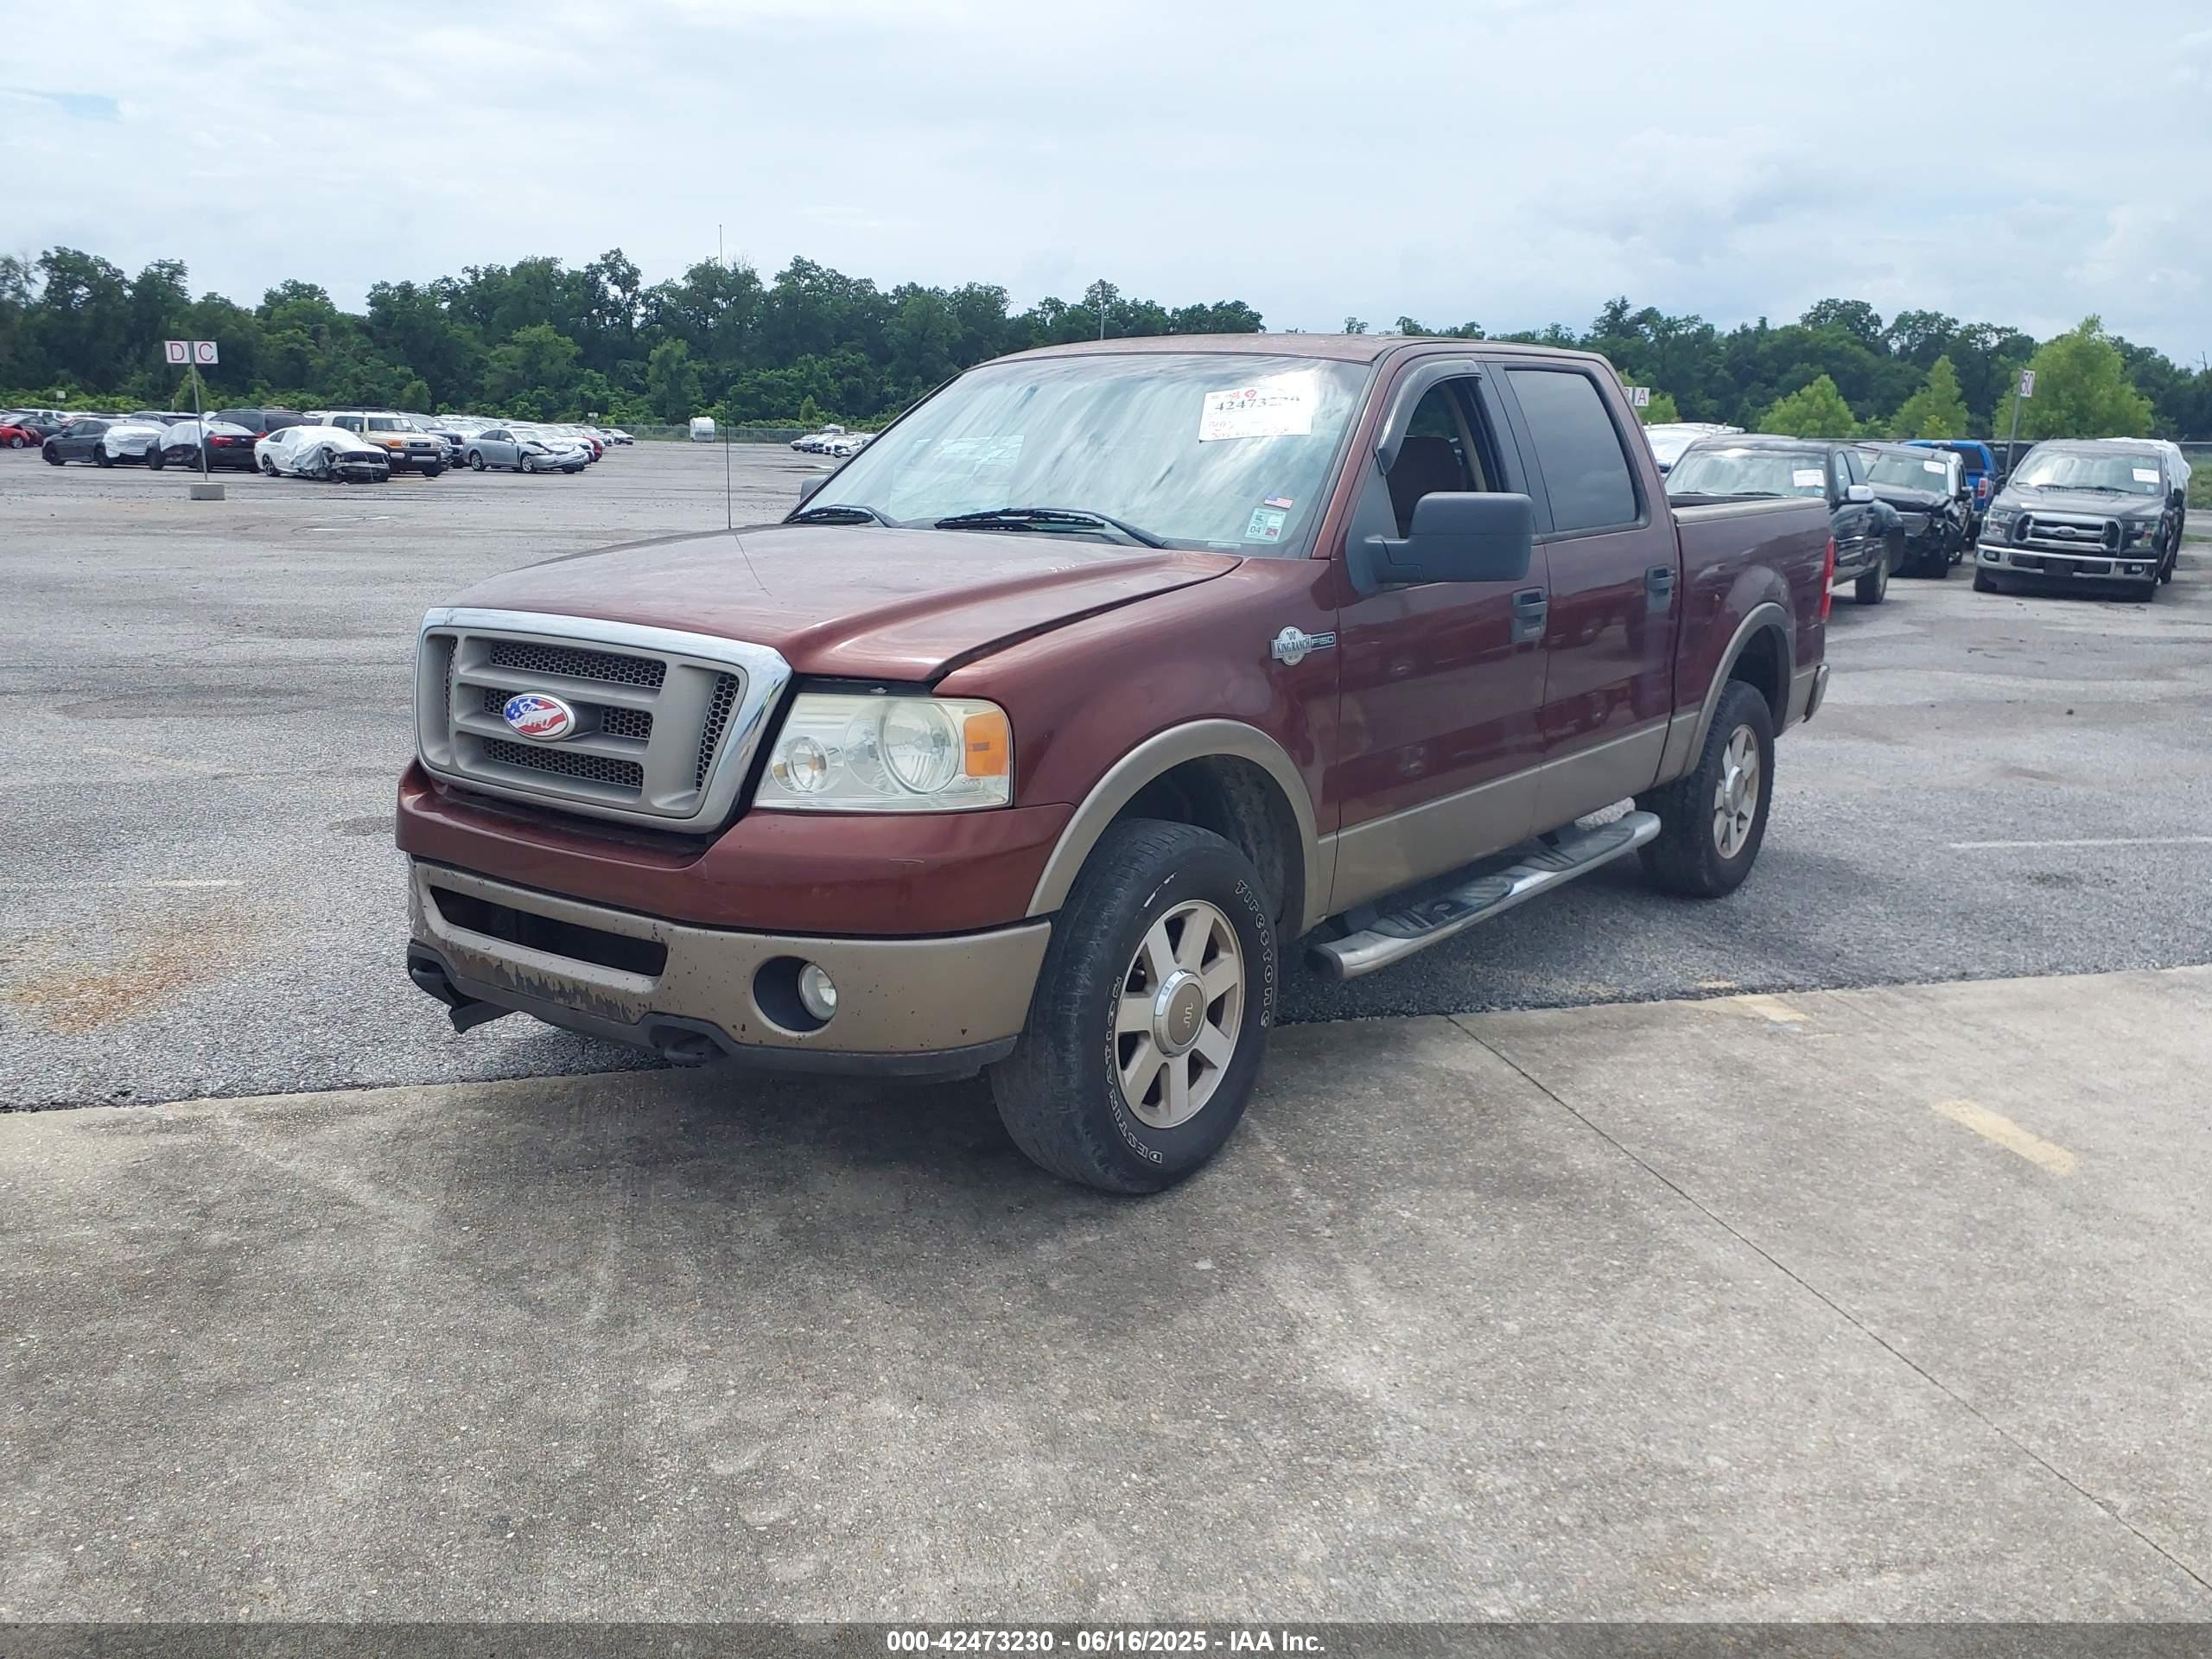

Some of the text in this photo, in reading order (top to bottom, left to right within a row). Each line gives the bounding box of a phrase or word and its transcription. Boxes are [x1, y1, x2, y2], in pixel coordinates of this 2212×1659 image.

[169, 342, 213, 361] D C
[1214, 397, 1300, 411] 42473
[1637, 389, 1647, 404] A
